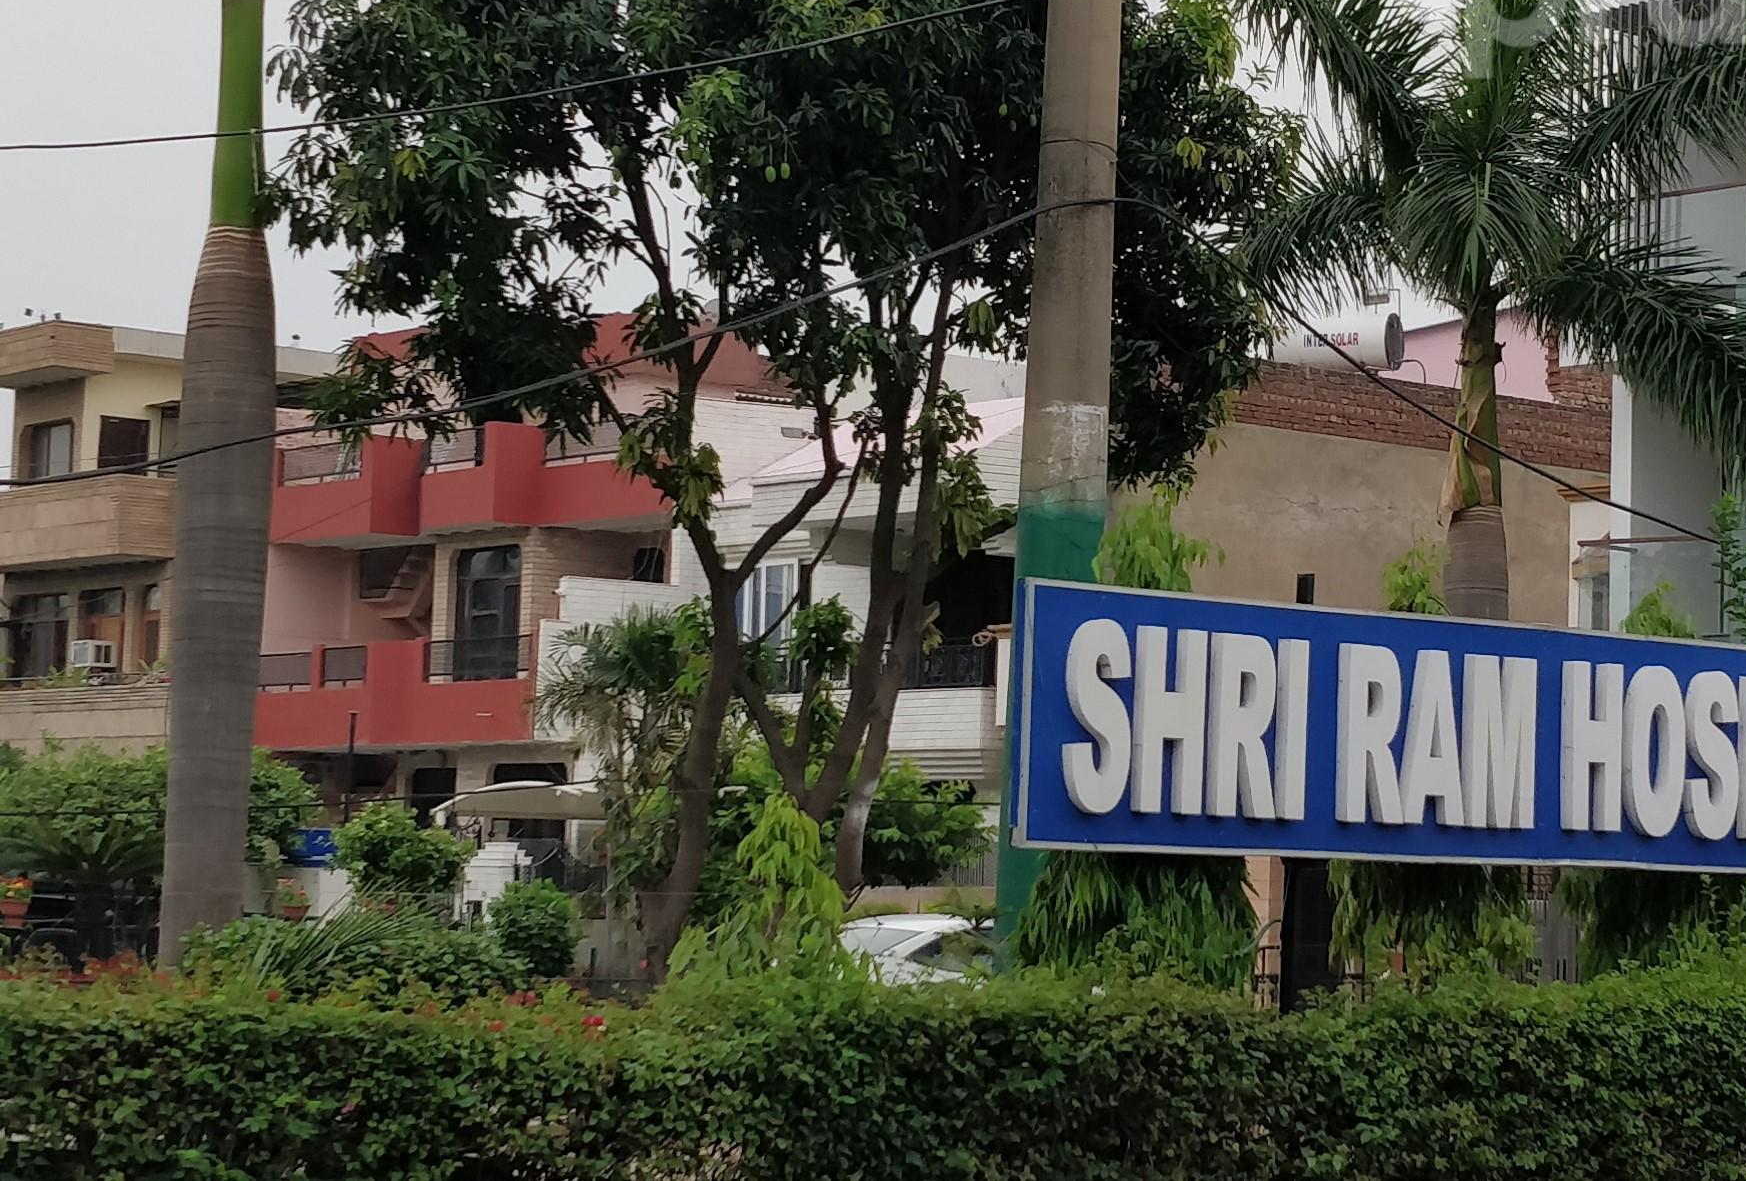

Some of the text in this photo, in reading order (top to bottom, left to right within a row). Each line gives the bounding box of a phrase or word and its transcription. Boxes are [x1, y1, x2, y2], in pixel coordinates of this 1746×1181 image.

[1303, 331, 1360, 348] INTER SOLAR
[1061, 618, 1310, 821] SHRI
[1336, 642, 1538, 829] RAM
